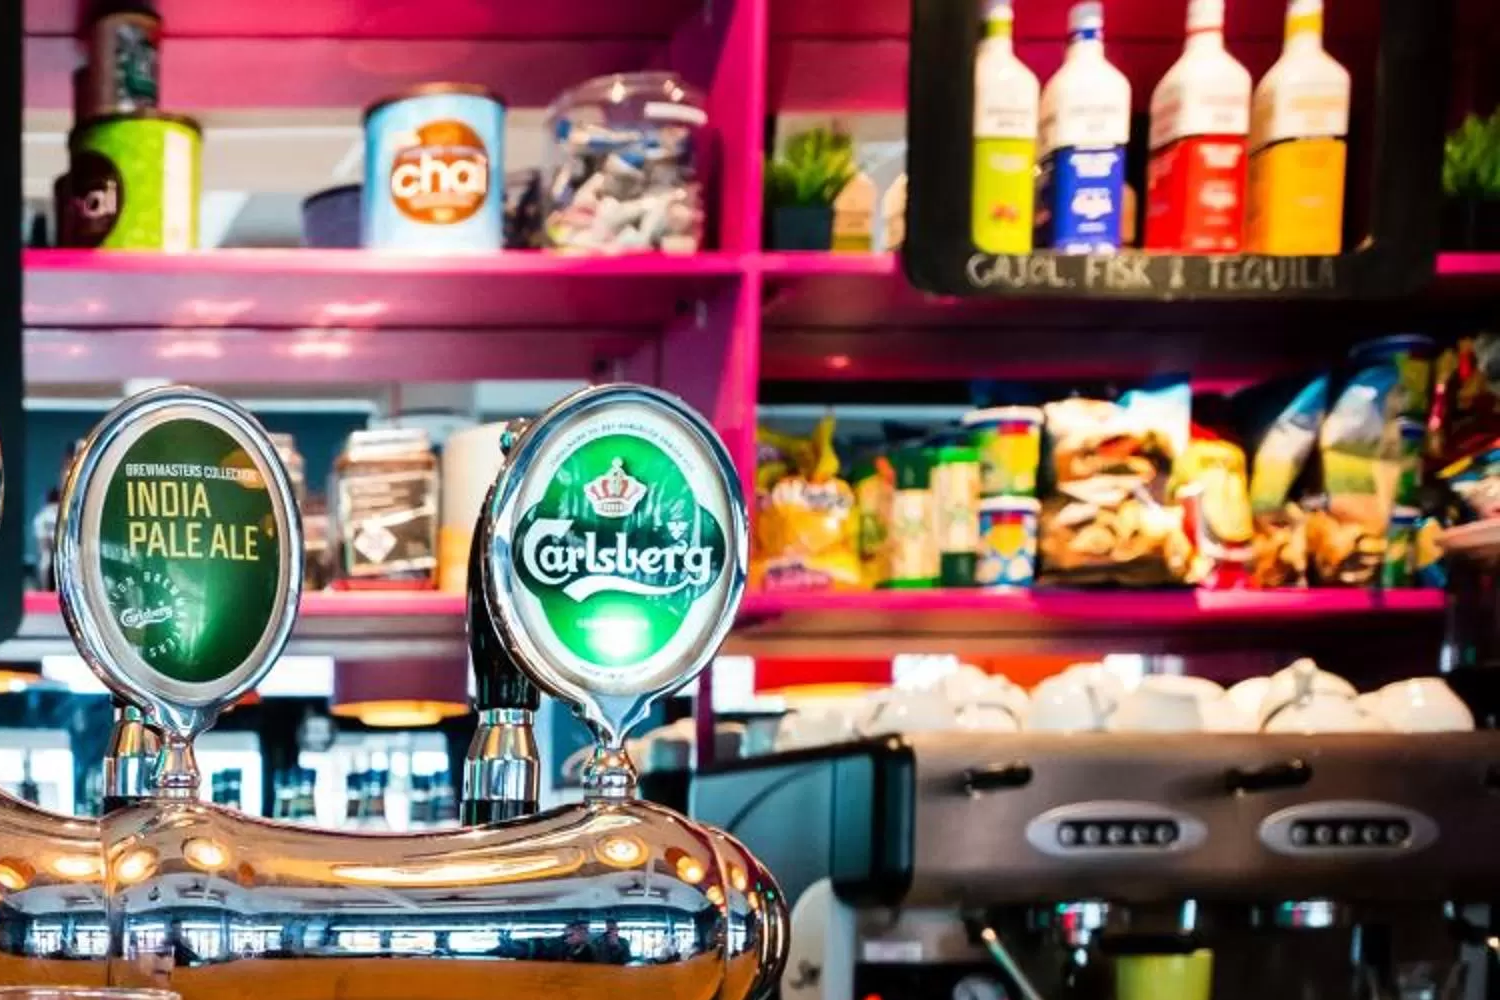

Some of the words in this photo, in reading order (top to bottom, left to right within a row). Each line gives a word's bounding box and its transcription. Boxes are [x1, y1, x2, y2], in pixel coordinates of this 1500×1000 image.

[126, 481, 212, 518] INDIA
[128, 521, 203, 558] PALE
[209, 523, 260, 561] ALE
[522, 517, 715, 586] Carlsberg
